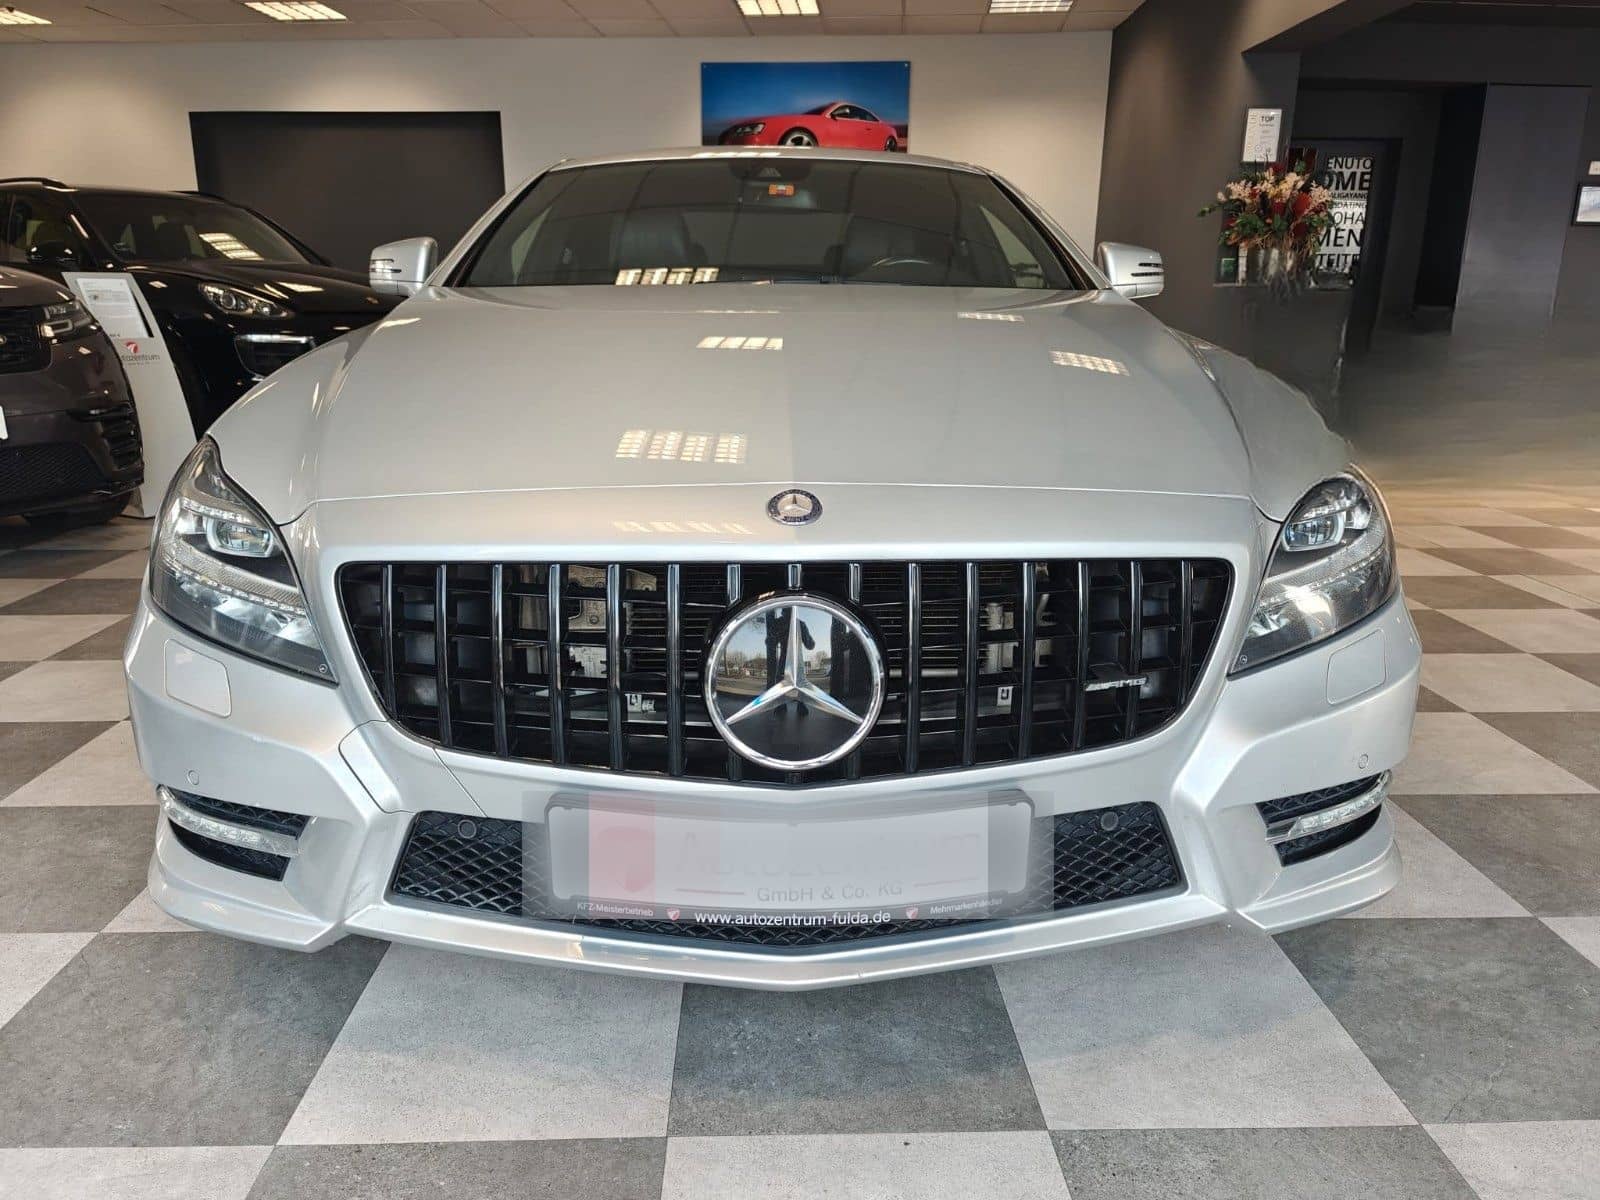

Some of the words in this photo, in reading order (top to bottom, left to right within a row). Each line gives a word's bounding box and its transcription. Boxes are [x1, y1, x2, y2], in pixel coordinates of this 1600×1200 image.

[756, 886, 814, 902] GmbH
[820, 884, 834, 900] &
[842, 883, 868, 899] Co.
[878, 880, 903, 896] KG
[694, 910, 891, 926] www.autozentrum-fulda.de
